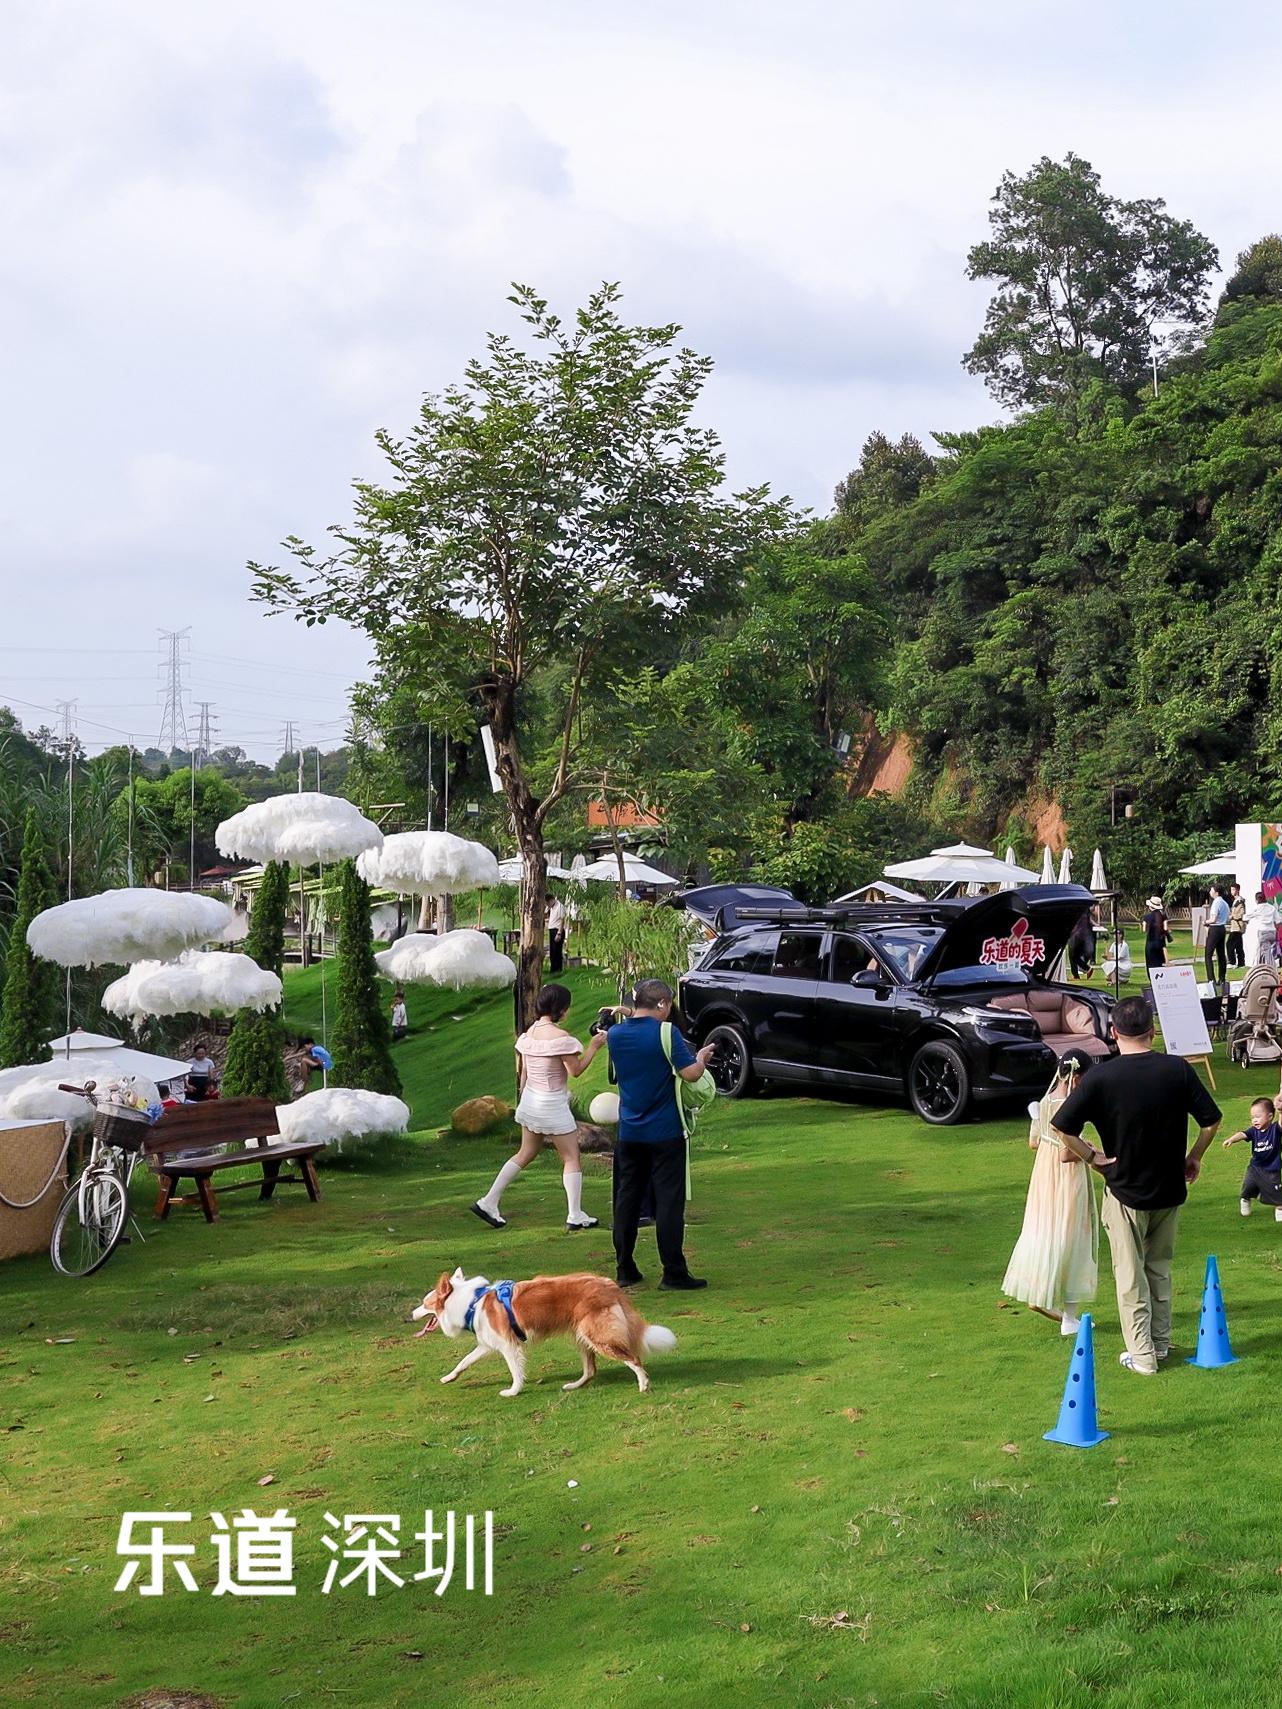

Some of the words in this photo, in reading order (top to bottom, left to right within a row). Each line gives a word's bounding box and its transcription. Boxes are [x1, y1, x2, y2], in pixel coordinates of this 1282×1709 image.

[980, 936, 1044, 966] 乐道的夏天
